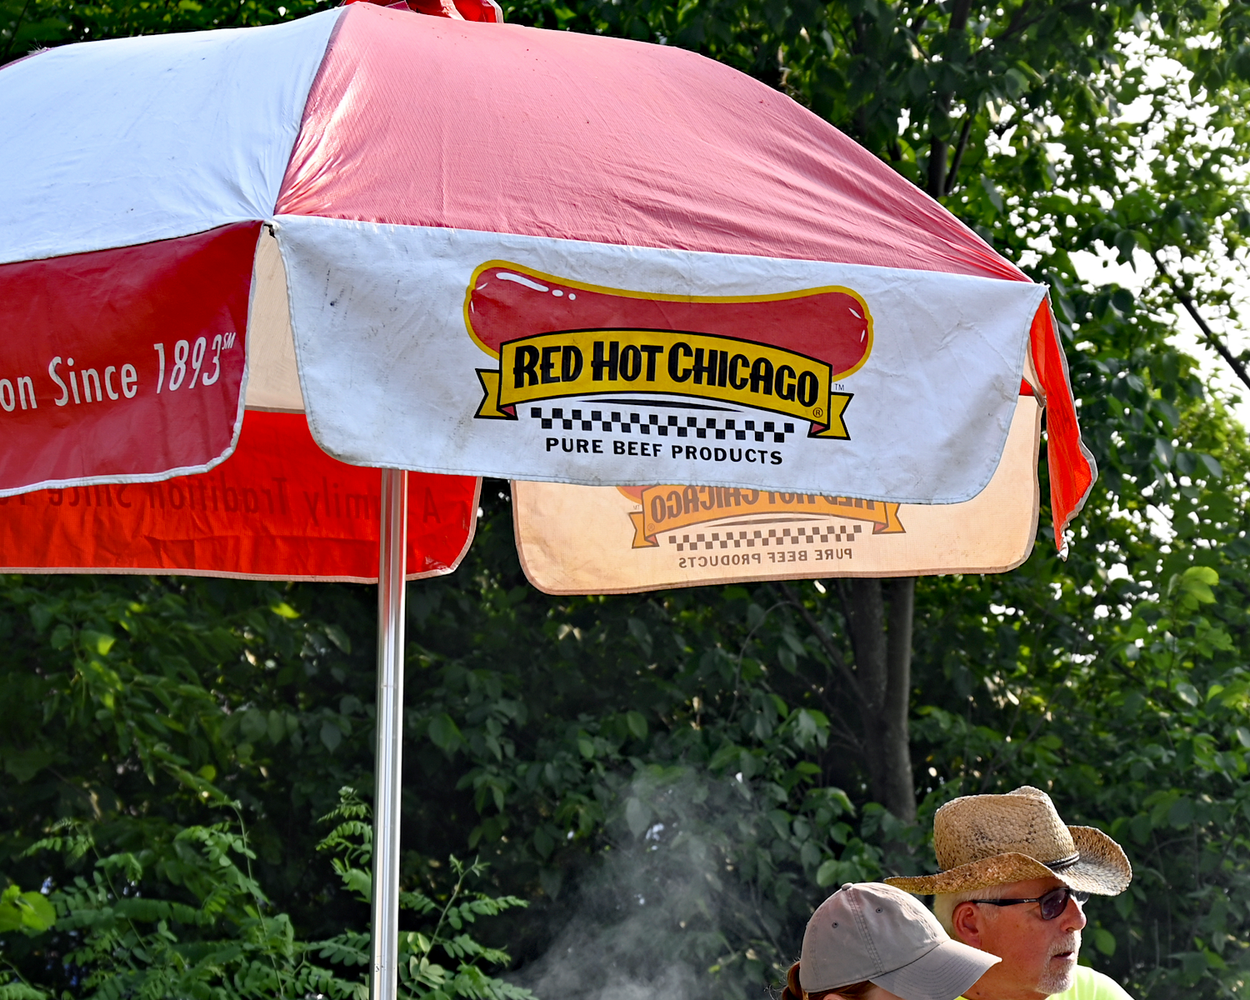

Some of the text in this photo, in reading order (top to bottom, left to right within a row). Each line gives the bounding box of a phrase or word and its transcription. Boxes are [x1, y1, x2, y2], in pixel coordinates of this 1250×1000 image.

[48, 356, 138, 408] Since
[153, 336, 222, 394] 1893
[513, 340, 819, 408] RED HOT CHICAGO
[546, 437, 783, 465] PURE BEEF PRODUCTS
